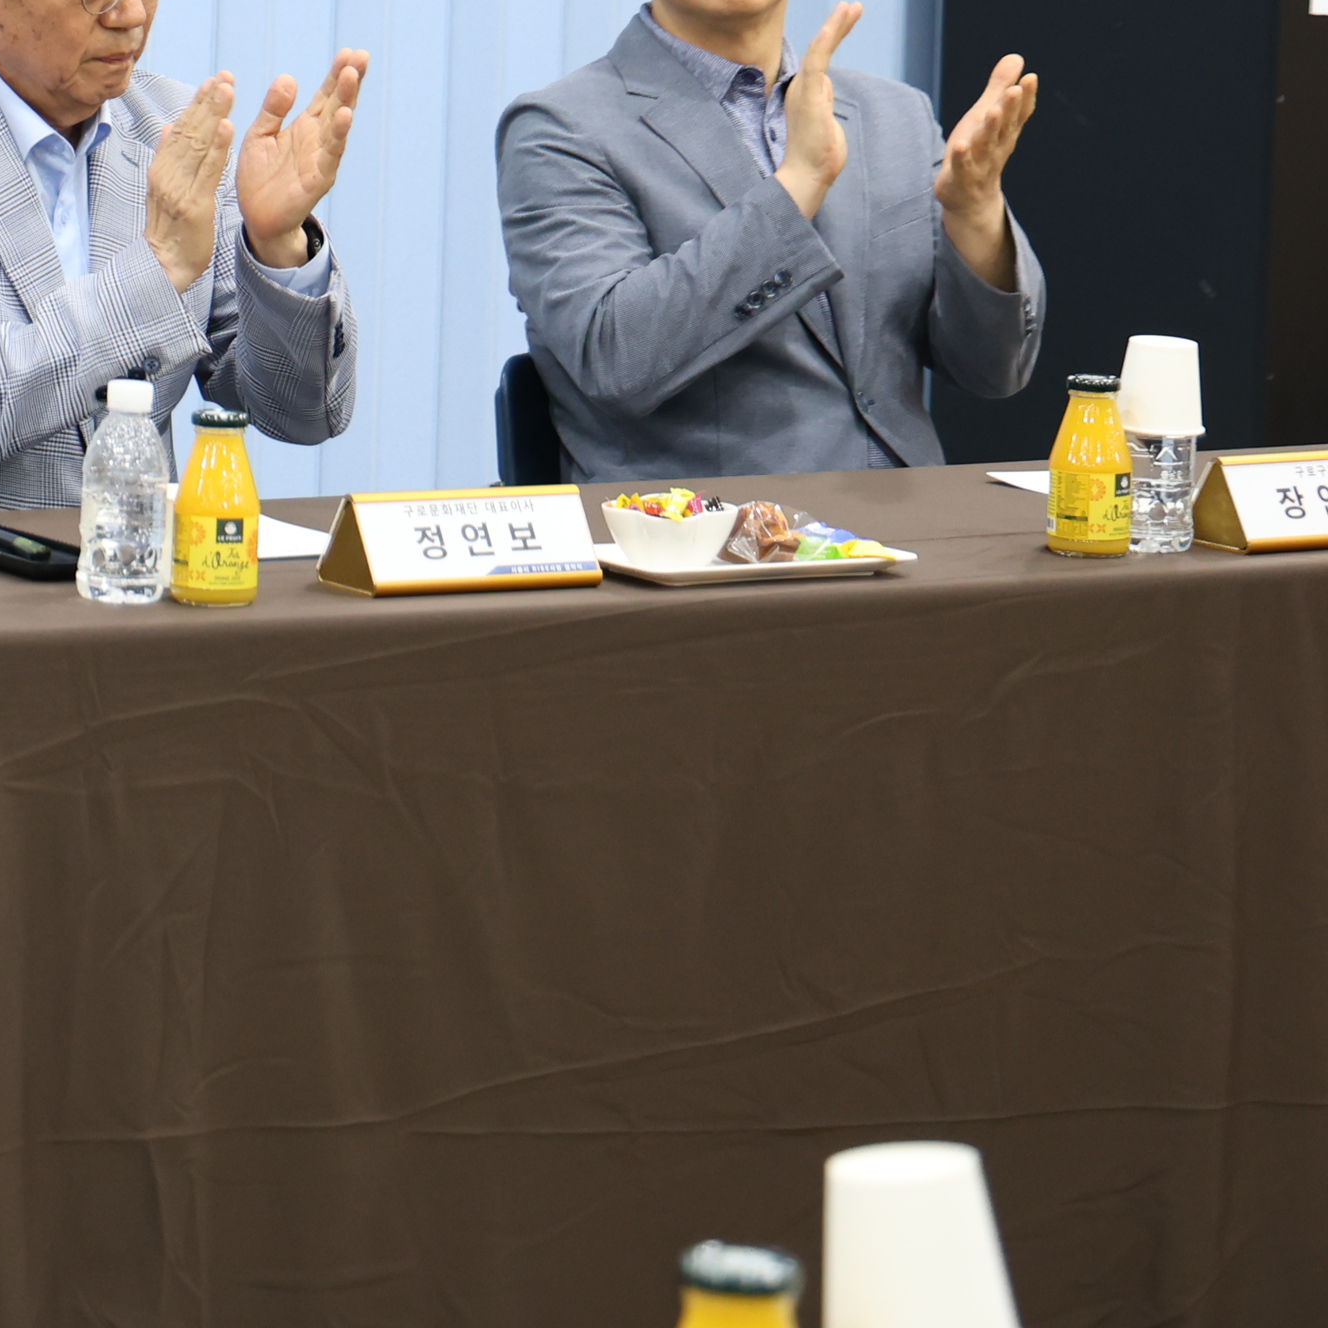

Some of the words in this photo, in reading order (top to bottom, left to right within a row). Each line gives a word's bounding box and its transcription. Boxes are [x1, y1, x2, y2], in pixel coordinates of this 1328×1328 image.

[1295, 465, 1328, 478] 구로구
[403, 502, 479, 518] 구로문화재단
[485, 499, 534, 514] 대표이사
